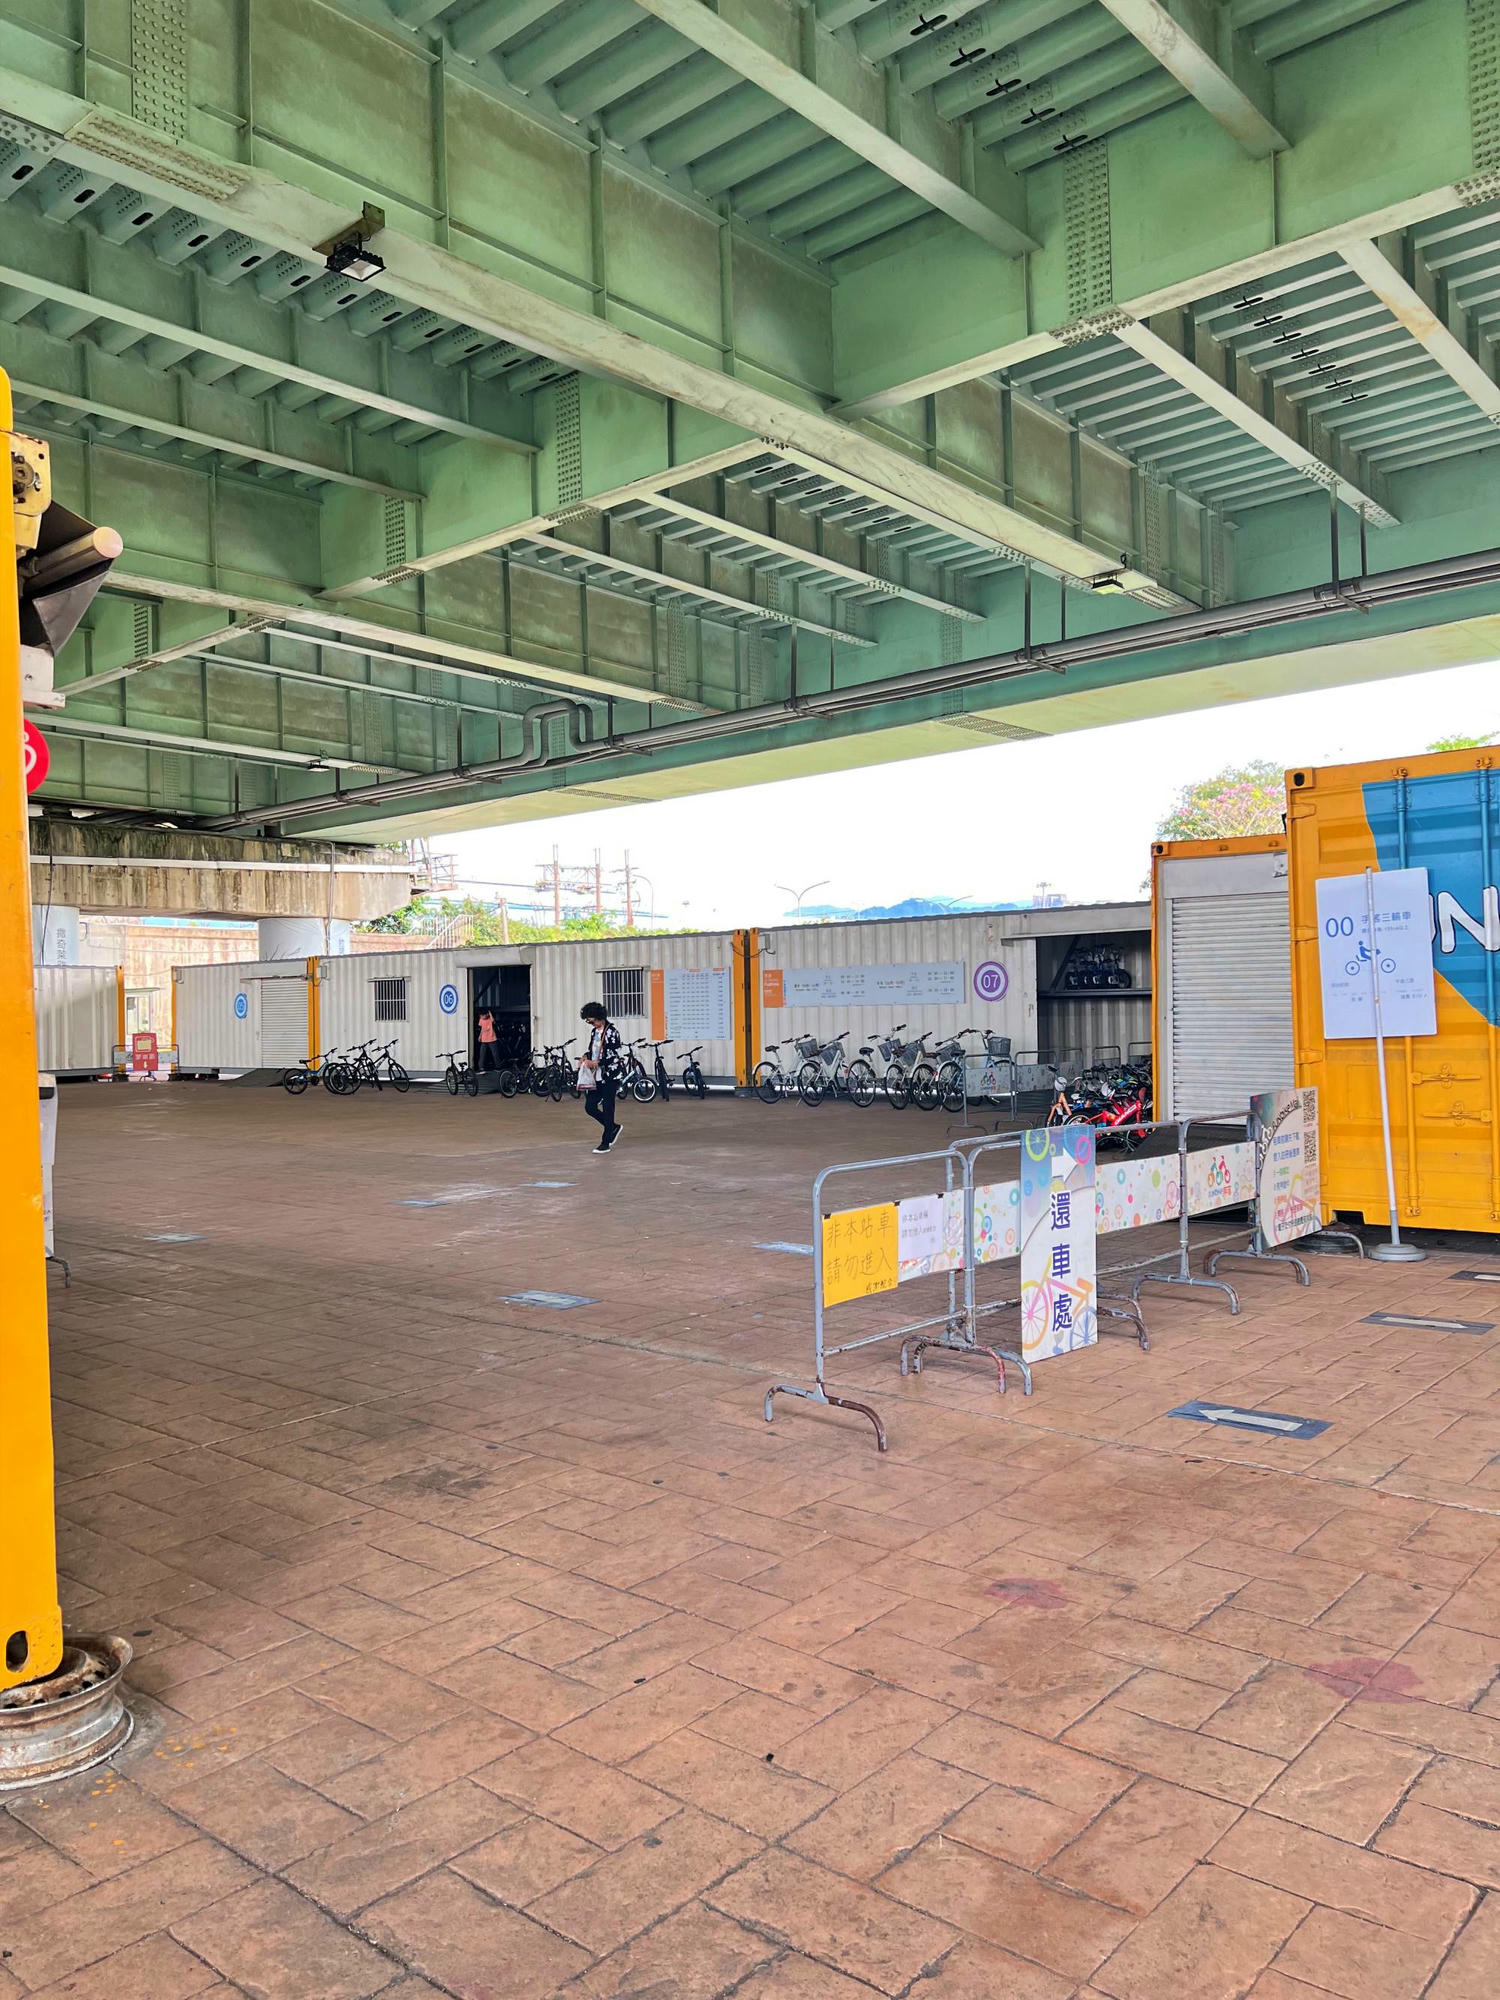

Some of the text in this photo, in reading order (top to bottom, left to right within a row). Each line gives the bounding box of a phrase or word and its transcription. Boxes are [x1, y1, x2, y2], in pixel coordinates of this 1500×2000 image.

[1326, 917, 1354, 937] 00
[983, 974, 998, 988] 07
[1051, 1192, 1072, 1332] 還車處
